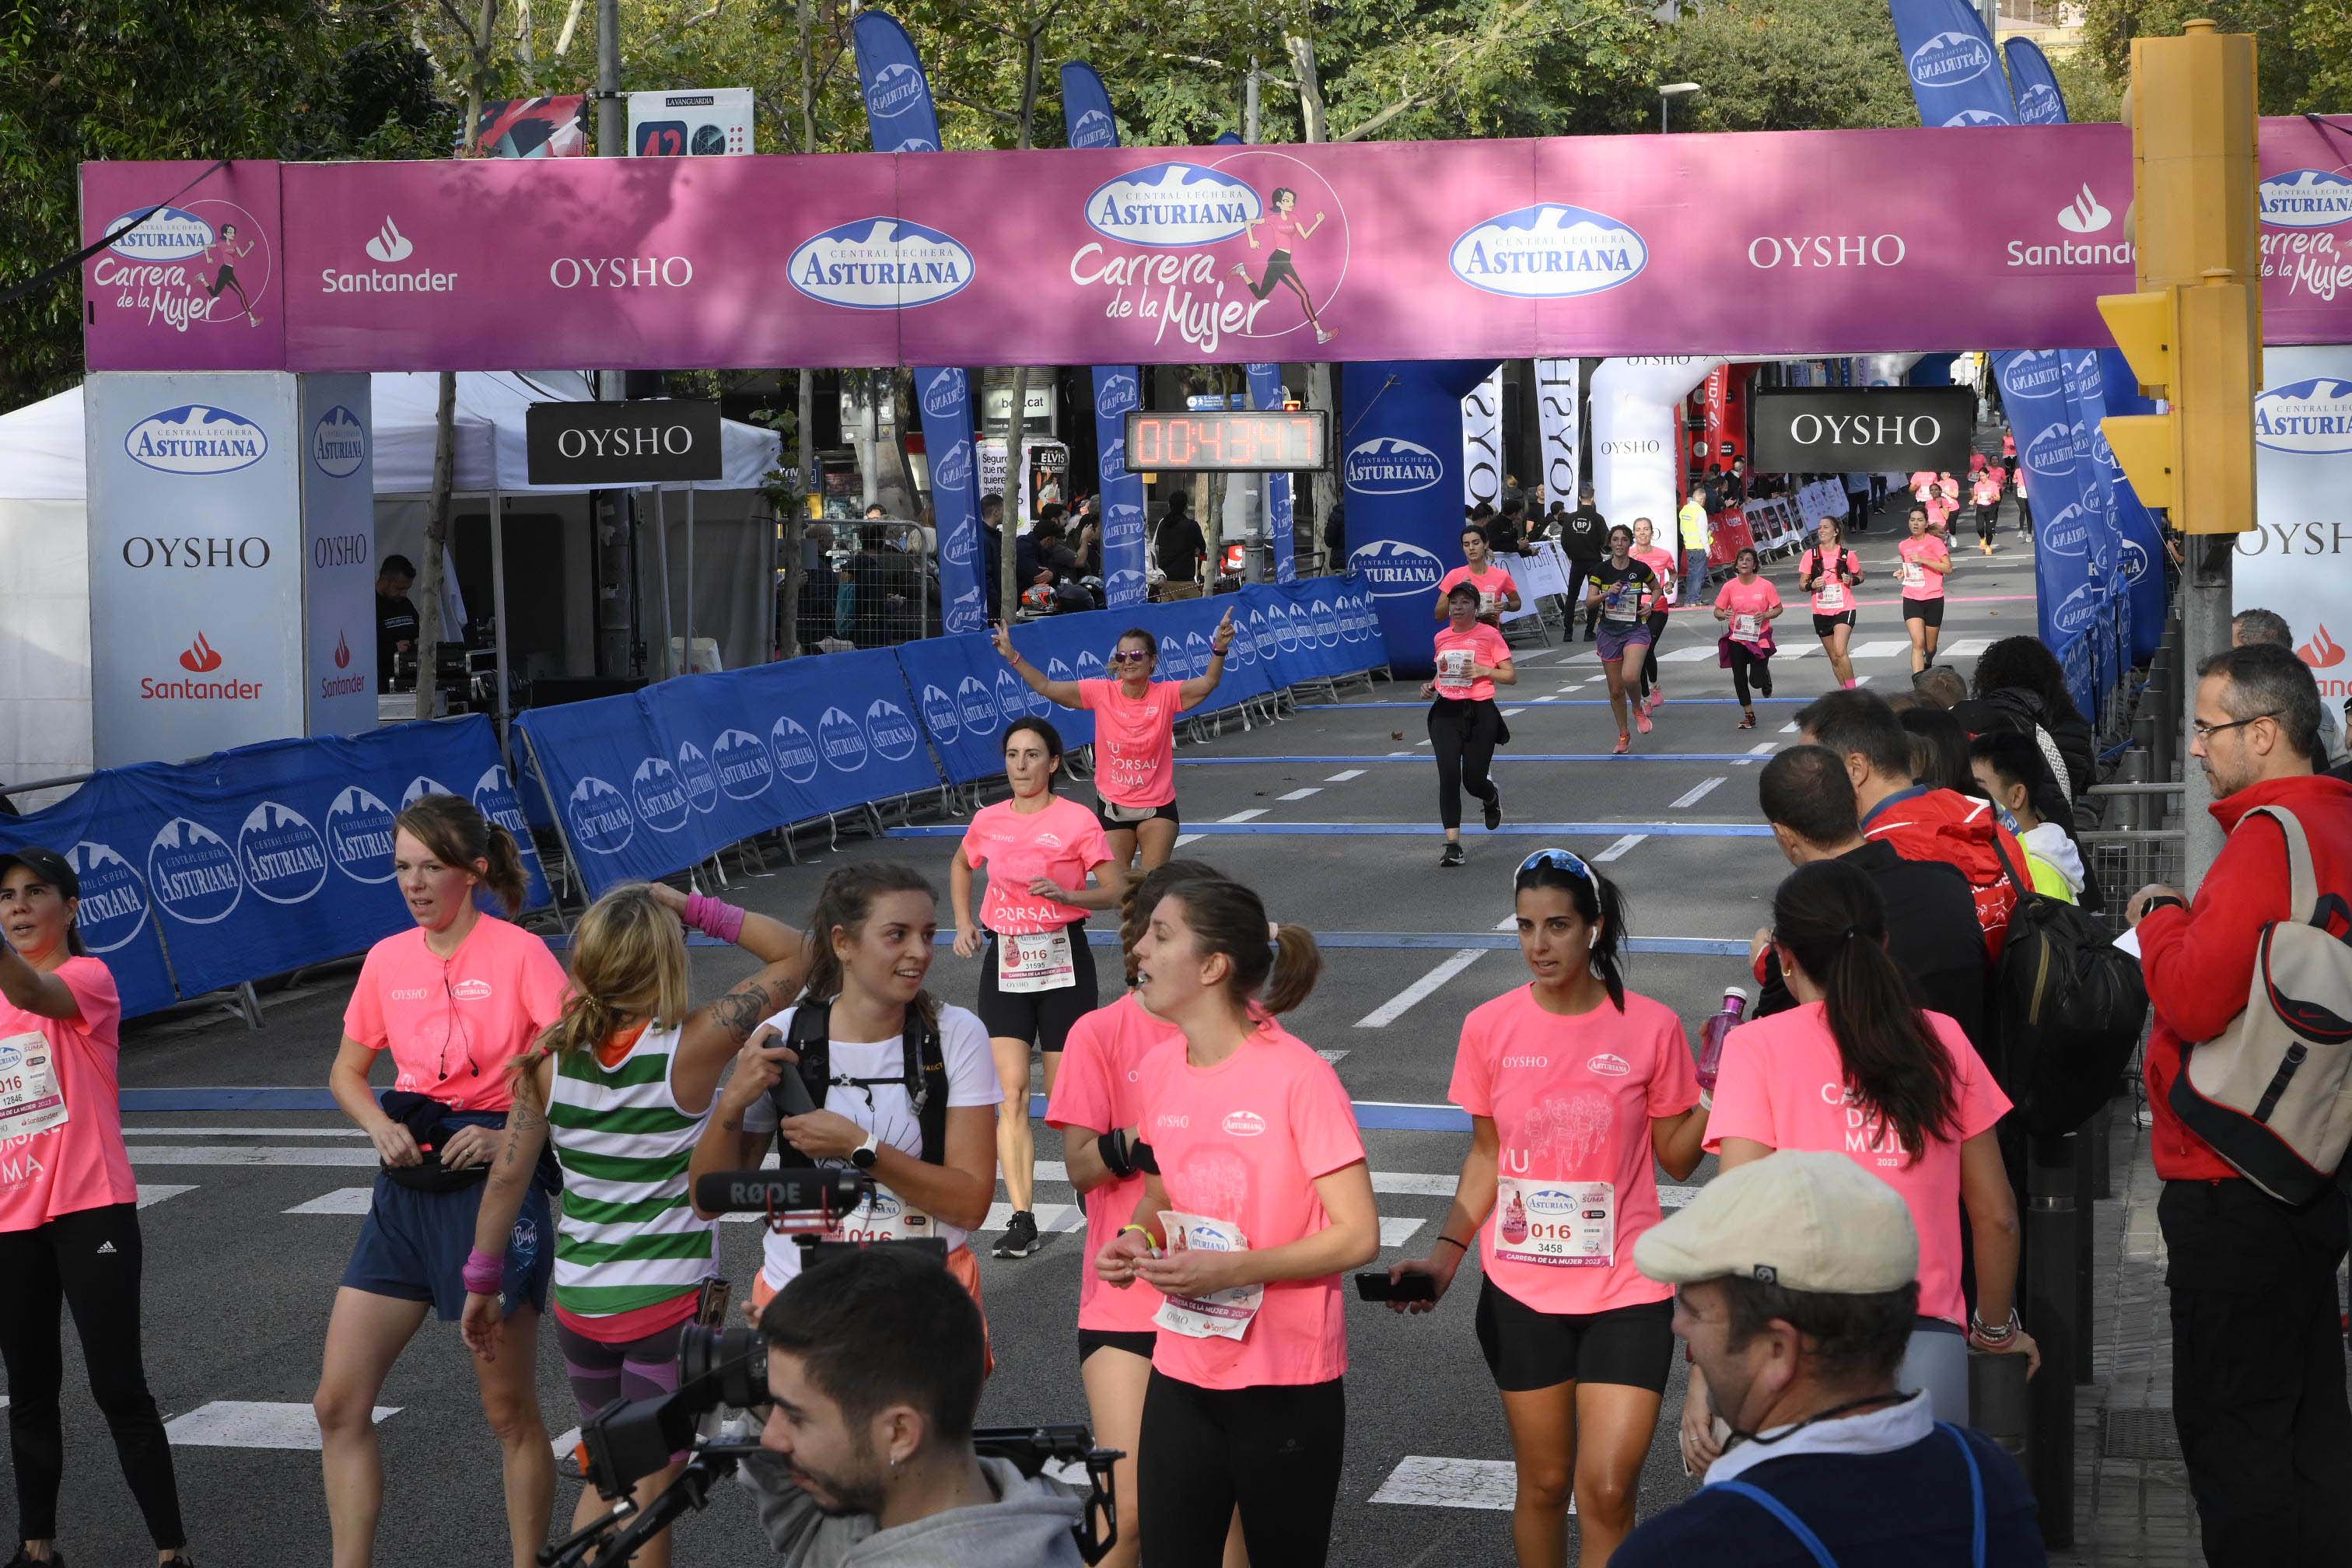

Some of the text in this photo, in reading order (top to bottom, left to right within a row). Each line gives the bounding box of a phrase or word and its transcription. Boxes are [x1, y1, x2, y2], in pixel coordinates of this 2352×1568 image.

[674, 96, 712, 106] VANGUARDIA
[1126, 191, 1180, 200] CENTRAL
[1098, 194, 1248, 226] ASTURIANA
[1563, 235, 1626, 243] LECHERA
[2260, 232, 2334, 255] arrera
[831, 249, 954, 257] CENTRAL LECHERA
[1466, 240, 1632, 274] ASTURIANA
[1748, 234, 1906, 268] OYSHO
[94, 257, 185, 286] Carrera
[550, 257, 694, 288] OYSHO
[802, 253, 960, 285] ASTURIANA
[1070, 243, 1218, 285] Carrera
[322, 268, 458, 293] Santander
[2289, 251, 2352, 302] Muje
[117, 284, 220, 332] de la Mujer
[1107, 282, 1270, 352] de la Mujer
[1790, 414, 1941, 446] OYSHO
[136, 432, 257, 457] ASTURIANA
[317, 433, 362, 460] ASTURIANA
[558, 425, 692, 458] OYSHO
[1601, 439, 1660, 455] OYSHO
[1041, 453, 1065, 463] ELVIS
[1348, 460, 1436, 481] ASTURIANA
[122, 537, 270, 569] OYSHO
[315, 534, 366, 569] OYSHO
[141, 678, 262, 699] Santander
[322, 675, 365, 698] Santander
[775, 744, 816, 768] ASTURIANA
[824, 733, 865, 758] ASTURIANA
[717, 756, 771, 787] ASTURIANA
[1111, 769, 1145, 786] SUMA
[254, 831, 311, 849] CENTRAL LECHERA
[247, 845, 323, 884] ASTURIANA
[157, 863, 238, 902] ASTURIANA
[1022, 949, 1048, 961] 016
[392, 989, 427, 1000] OYSHO
[24, 1044, 44, 1052] SUMA
[1502, 1056, 1548, 1068] OYSHO
[1591, 1060, 1629, 1073] ASTURIANA
[3, 1094, 23, 1106] 12846
[27, 1111, 59, 1125] Santander
[1877, 1158, 1898, 1167] 2023
[730, 1182, 801, 1203] RØDE
[1529, 1199, 1574, 1209] ASTURIANA
[1531, 1223, 1571, 1239] 016
[1506, 1254, 1535, 1262] CARRERA
[1538, 1244, 1563, 1253] 3458
[1205, 1305, 1229, 1316] MUJER
